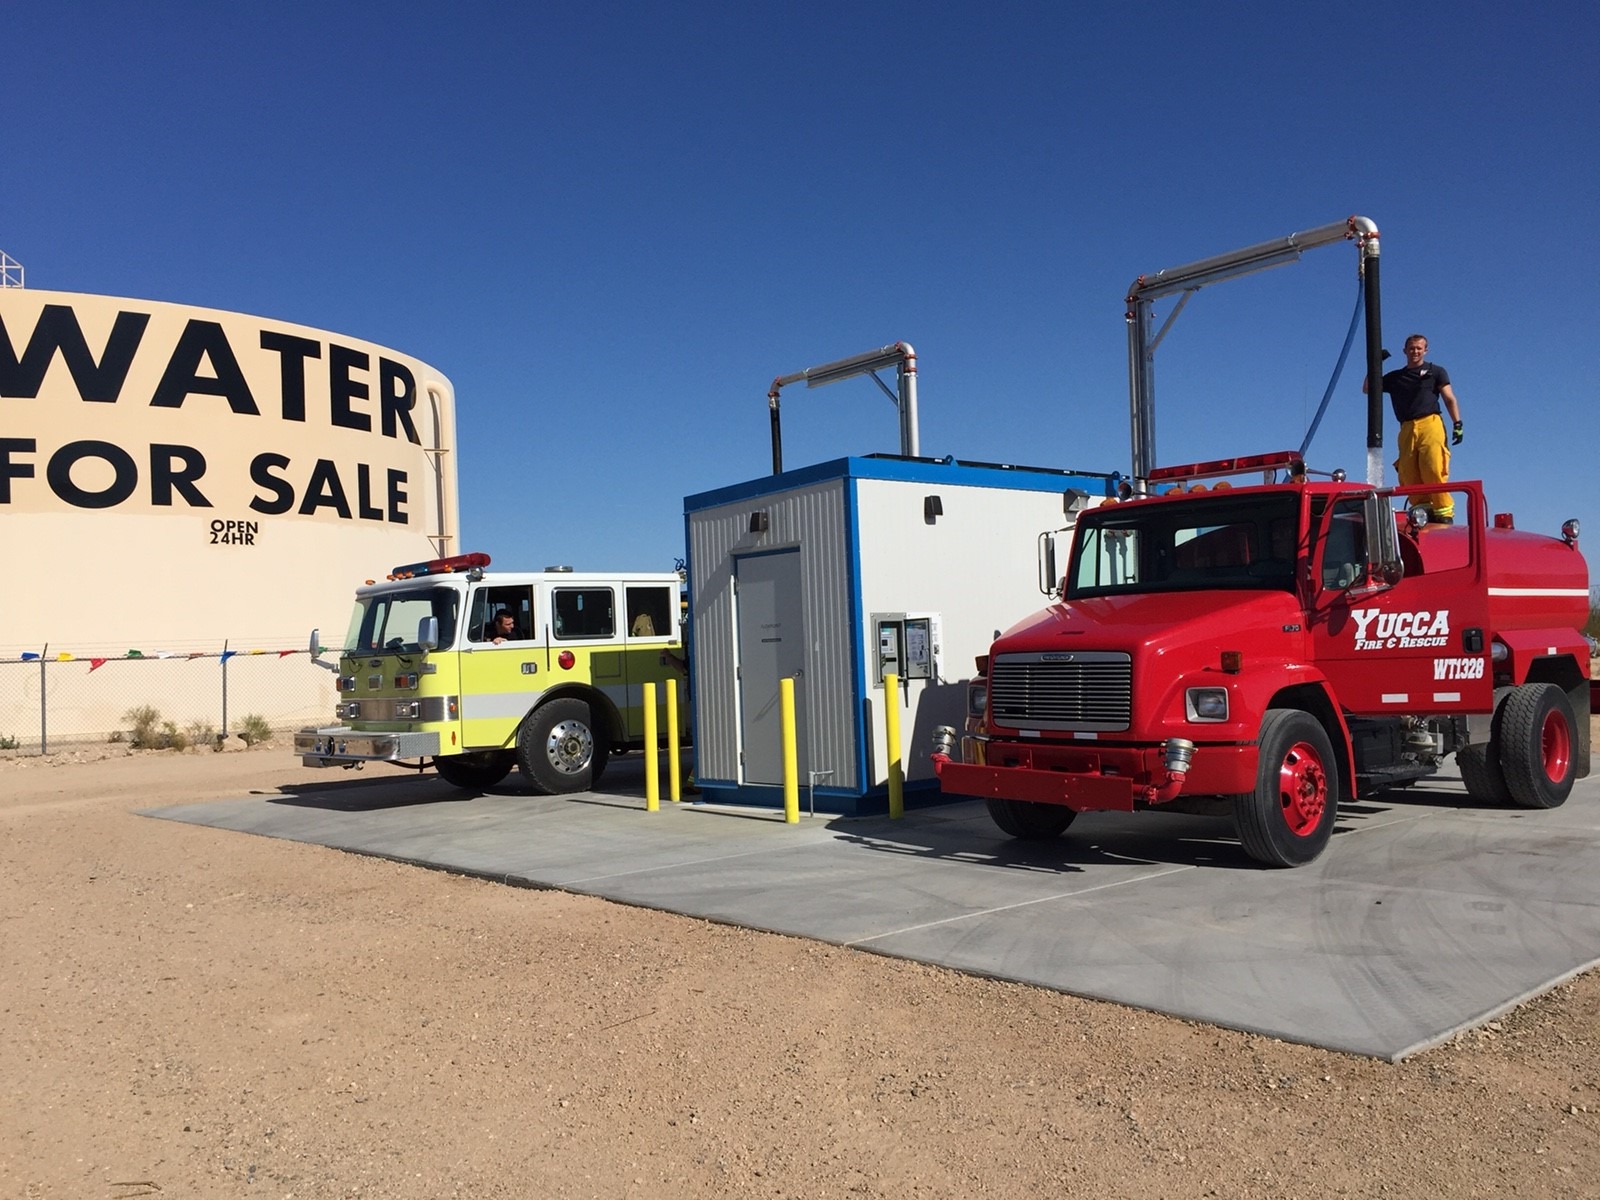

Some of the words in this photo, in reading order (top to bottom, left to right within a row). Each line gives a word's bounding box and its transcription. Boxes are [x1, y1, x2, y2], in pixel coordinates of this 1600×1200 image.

[0, 304, 422, 446] WATER
[0, 438, 214, 509] FOR
[249, 452, 409, 525] SALE
[210, 519, 258, 534] OPEN
[210, 531, 255, 546] 24HR
[1351, 608, 1450, 640] YUCCA
[1354, 639, 1384, 650] FIRE
[1386, 637, 1397, 649] &
[1398, 636, 1448, 648] RESCUE
[1433, 657, 1485, 680] WT1328
